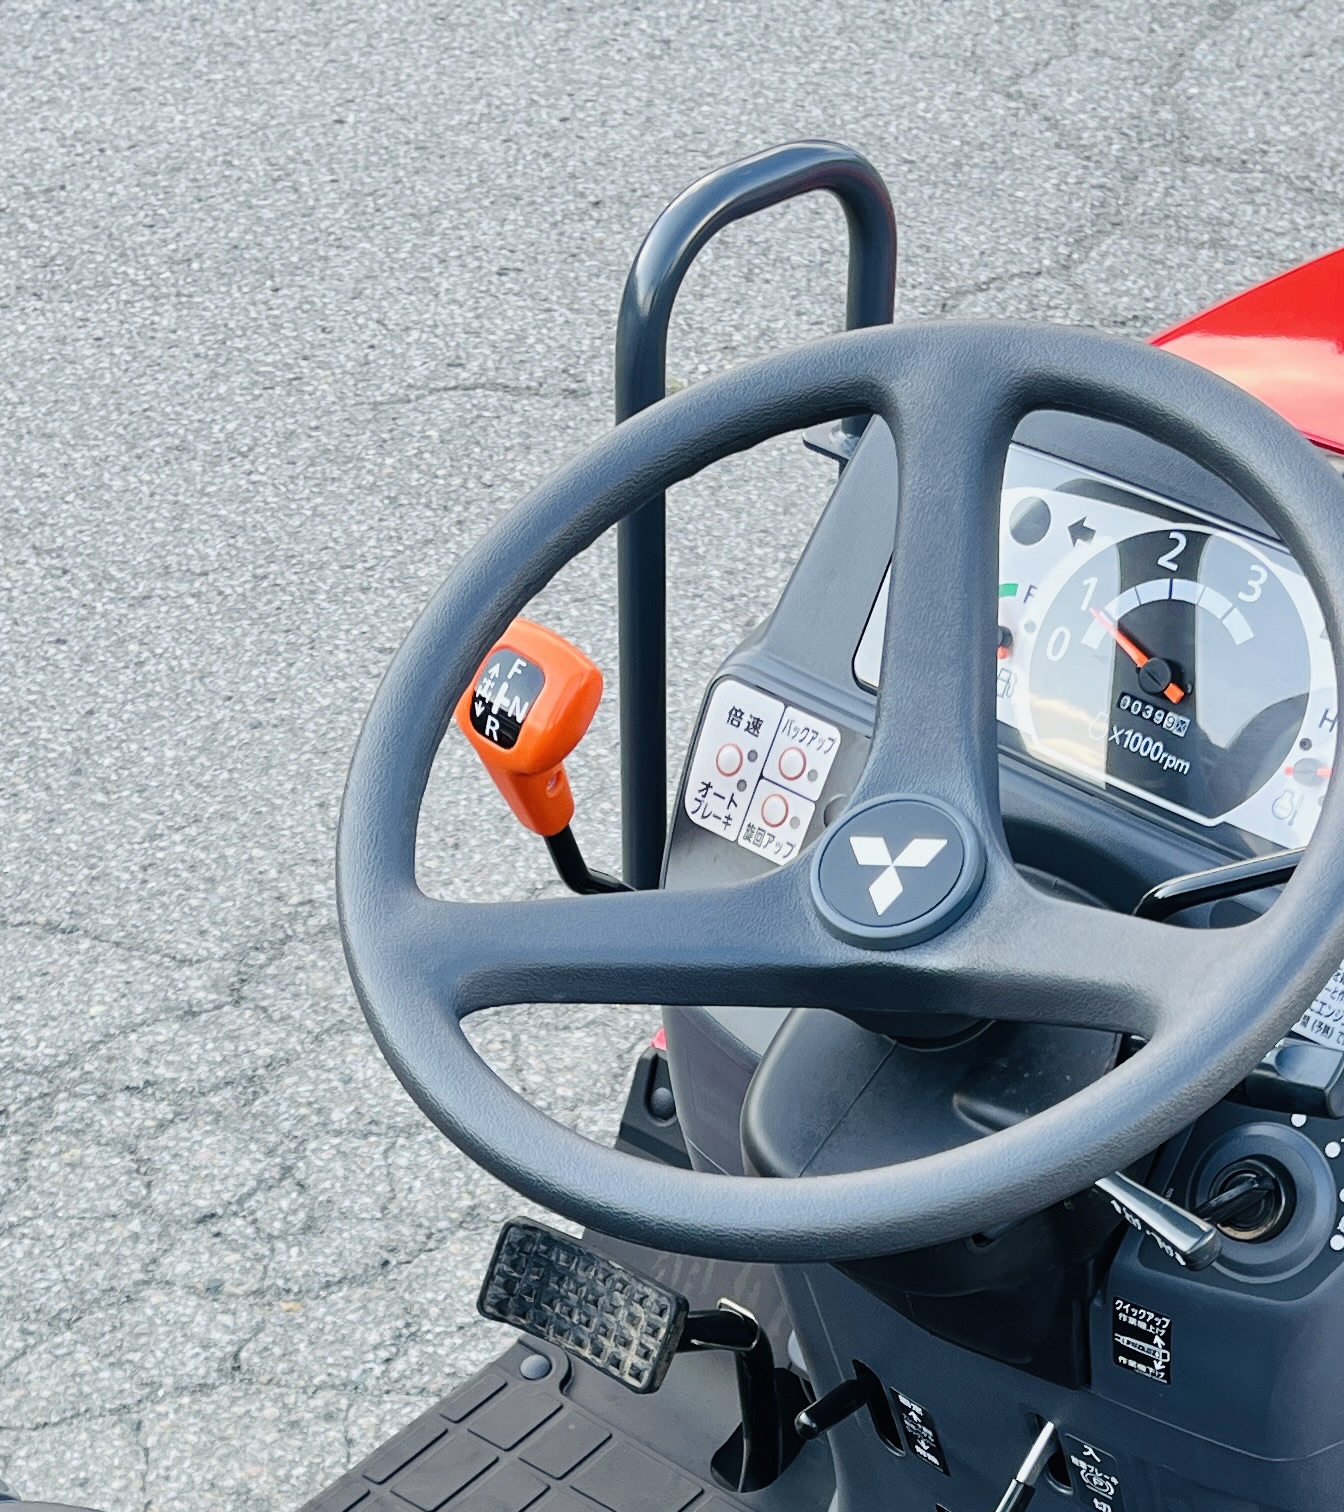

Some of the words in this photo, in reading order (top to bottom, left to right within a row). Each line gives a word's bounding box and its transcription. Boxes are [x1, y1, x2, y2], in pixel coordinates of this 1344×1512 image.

[1157, 532, 1187, 571] 2
[1080, 577, 1098, 610] 1
[1238, 564, 1268, 603] 3
[1046, 626, 1070, 661] 0
[507, 658, 527, 679] F
[508, 695, 529, 723] N
[726, 705, 764, 738] 倍速
[1318, 708, 1338, 732] H
[485, 714, 500, 741] R
[781, 718, 837, 755] バックアップ
[698, 780, 738, 811] オート
[690, 796, 734, 831] ブレーキ
[742, 822, 797, 859] 旋回アップ
[1082, 1444, 1102, 1463] 入
